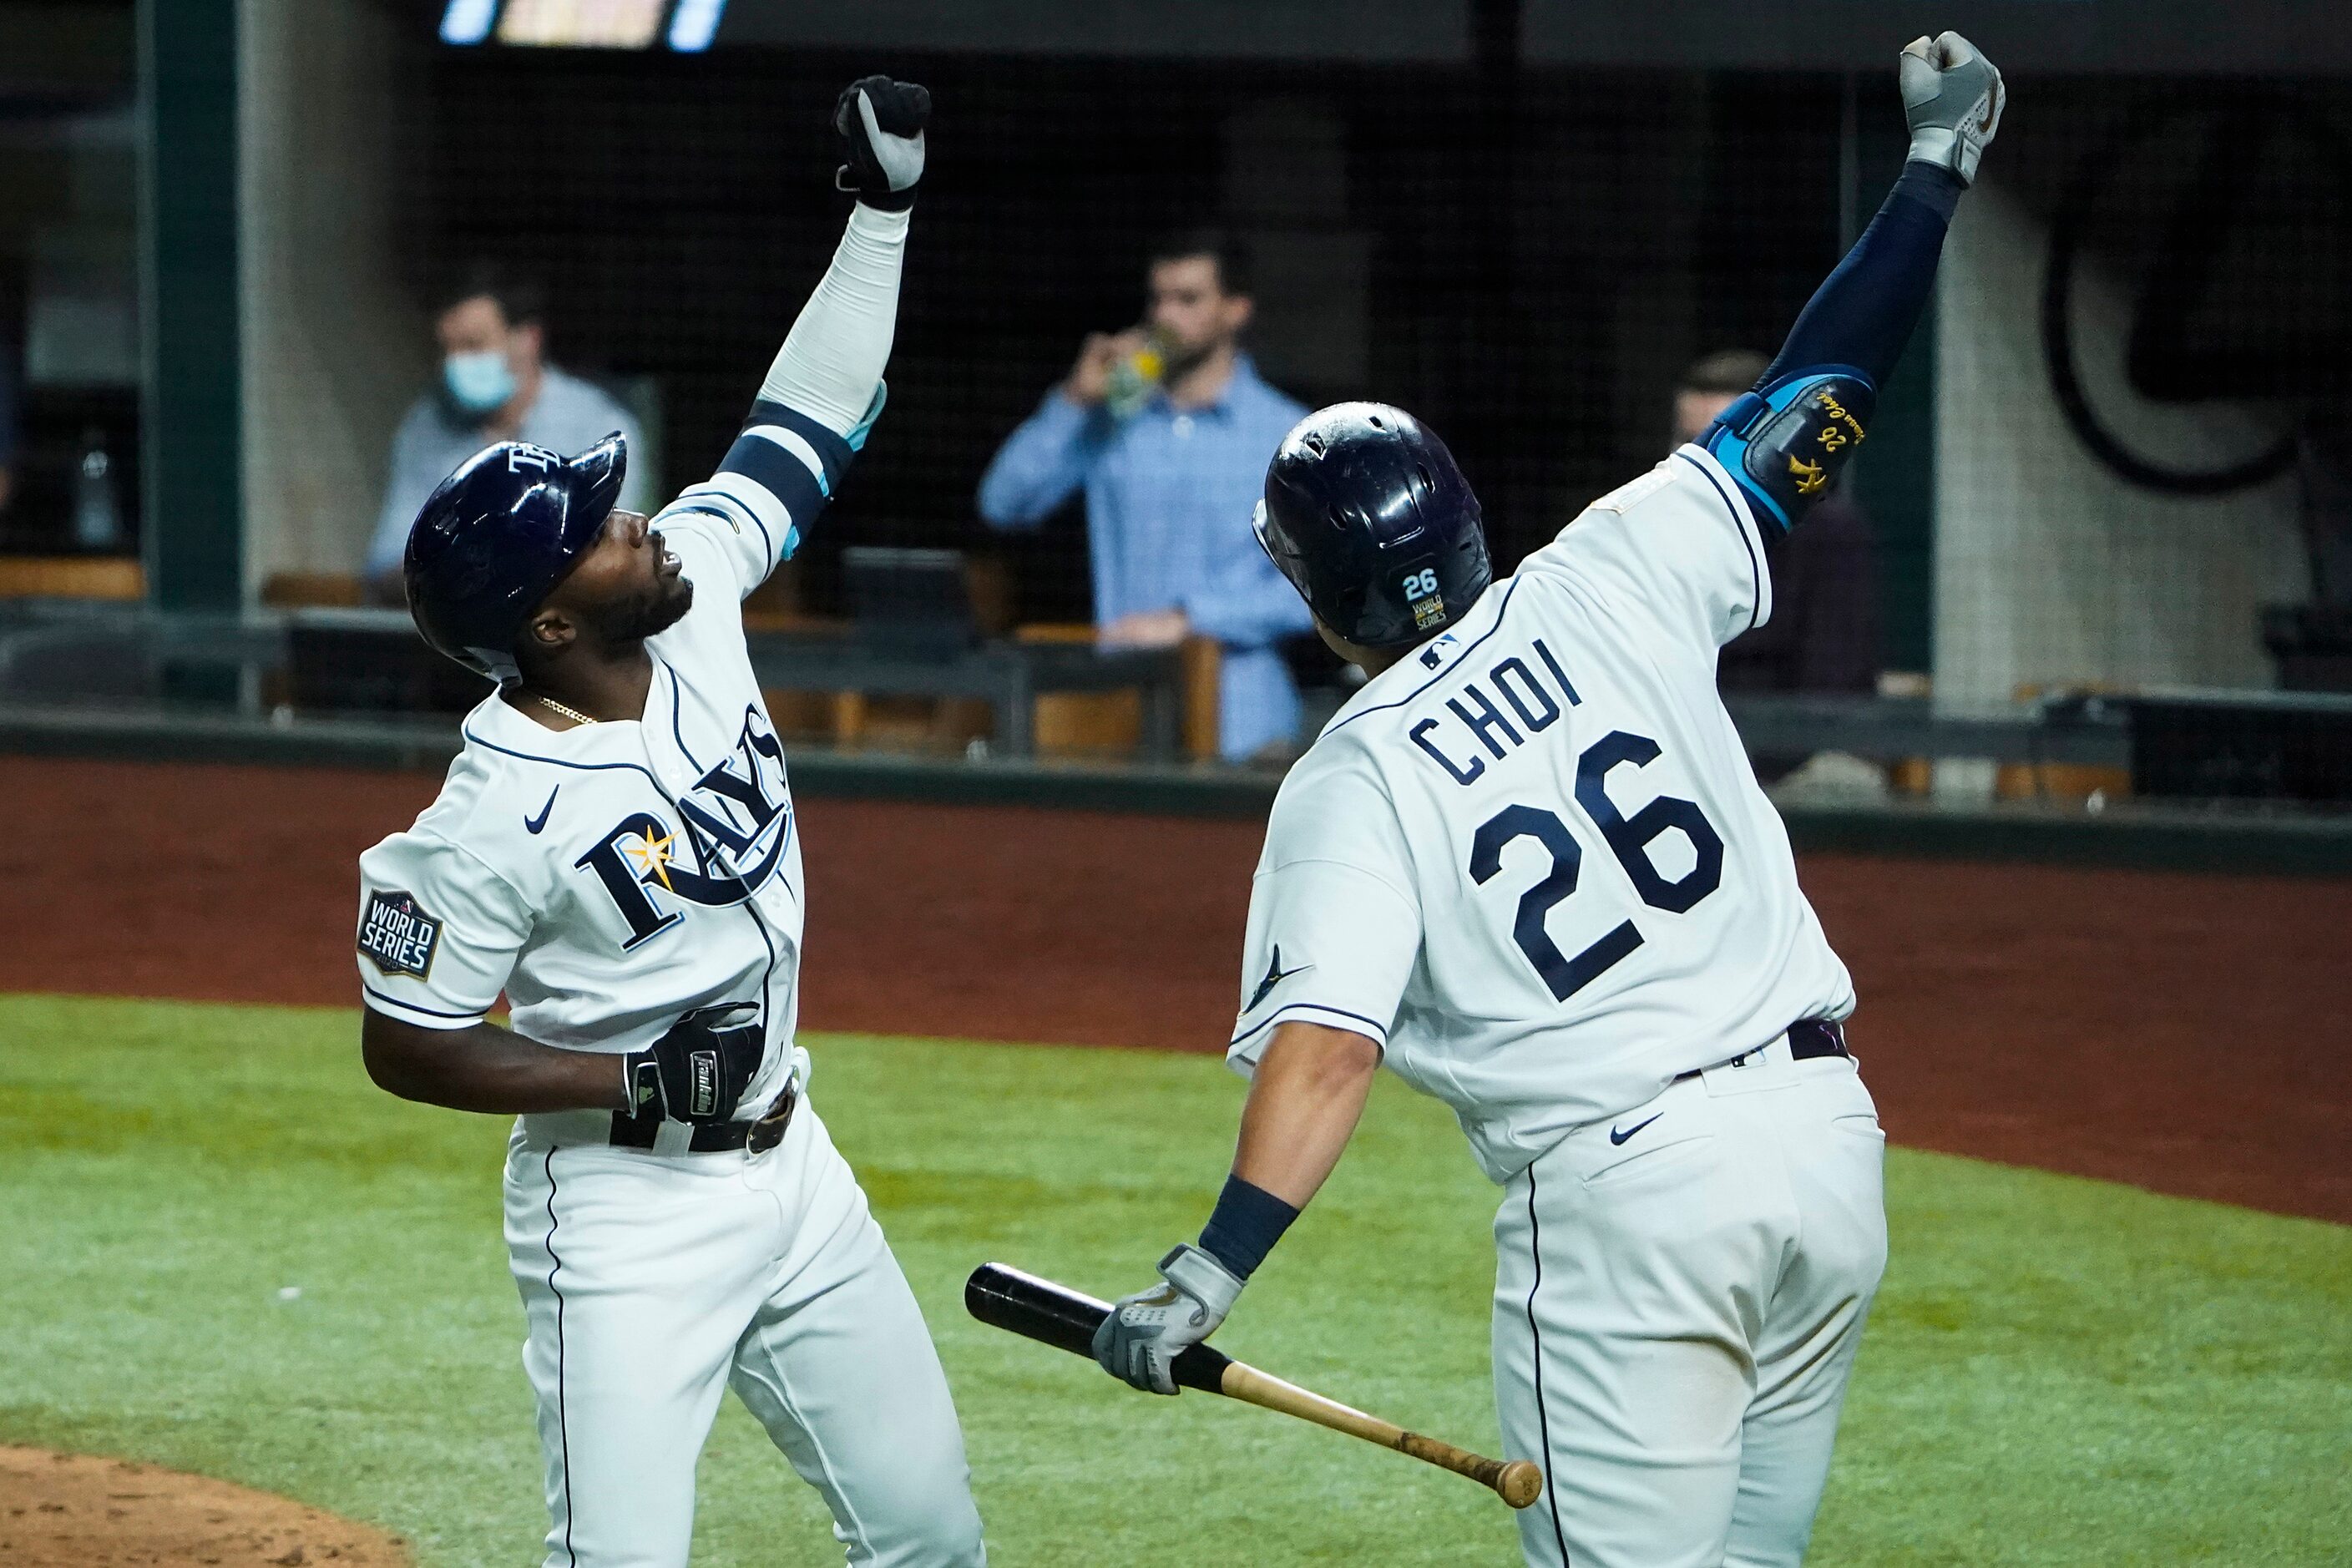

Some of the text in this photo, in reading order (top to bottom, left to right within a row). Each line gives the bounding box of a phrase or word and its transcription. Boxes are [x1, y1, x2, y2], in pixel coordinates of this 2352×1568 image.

[508, 442, 560, 473] TB
[1818, 427, 1847, 453] 26
[1403, 568, 1438, 601] 26
[1412, 594, 1443, 614] WORLD
[1417, 611, 1446, 630] SERIES
[1409, 639, 1582, 787] CHOI
[572, 700, 792, 952] RAYS
[1469, 730, 1725, 1003] 26
[362, 922, 427, 969] SERIES
[372, 899, 433, 946] WORLD
[694, 1055, 714, 1112] Franklin
